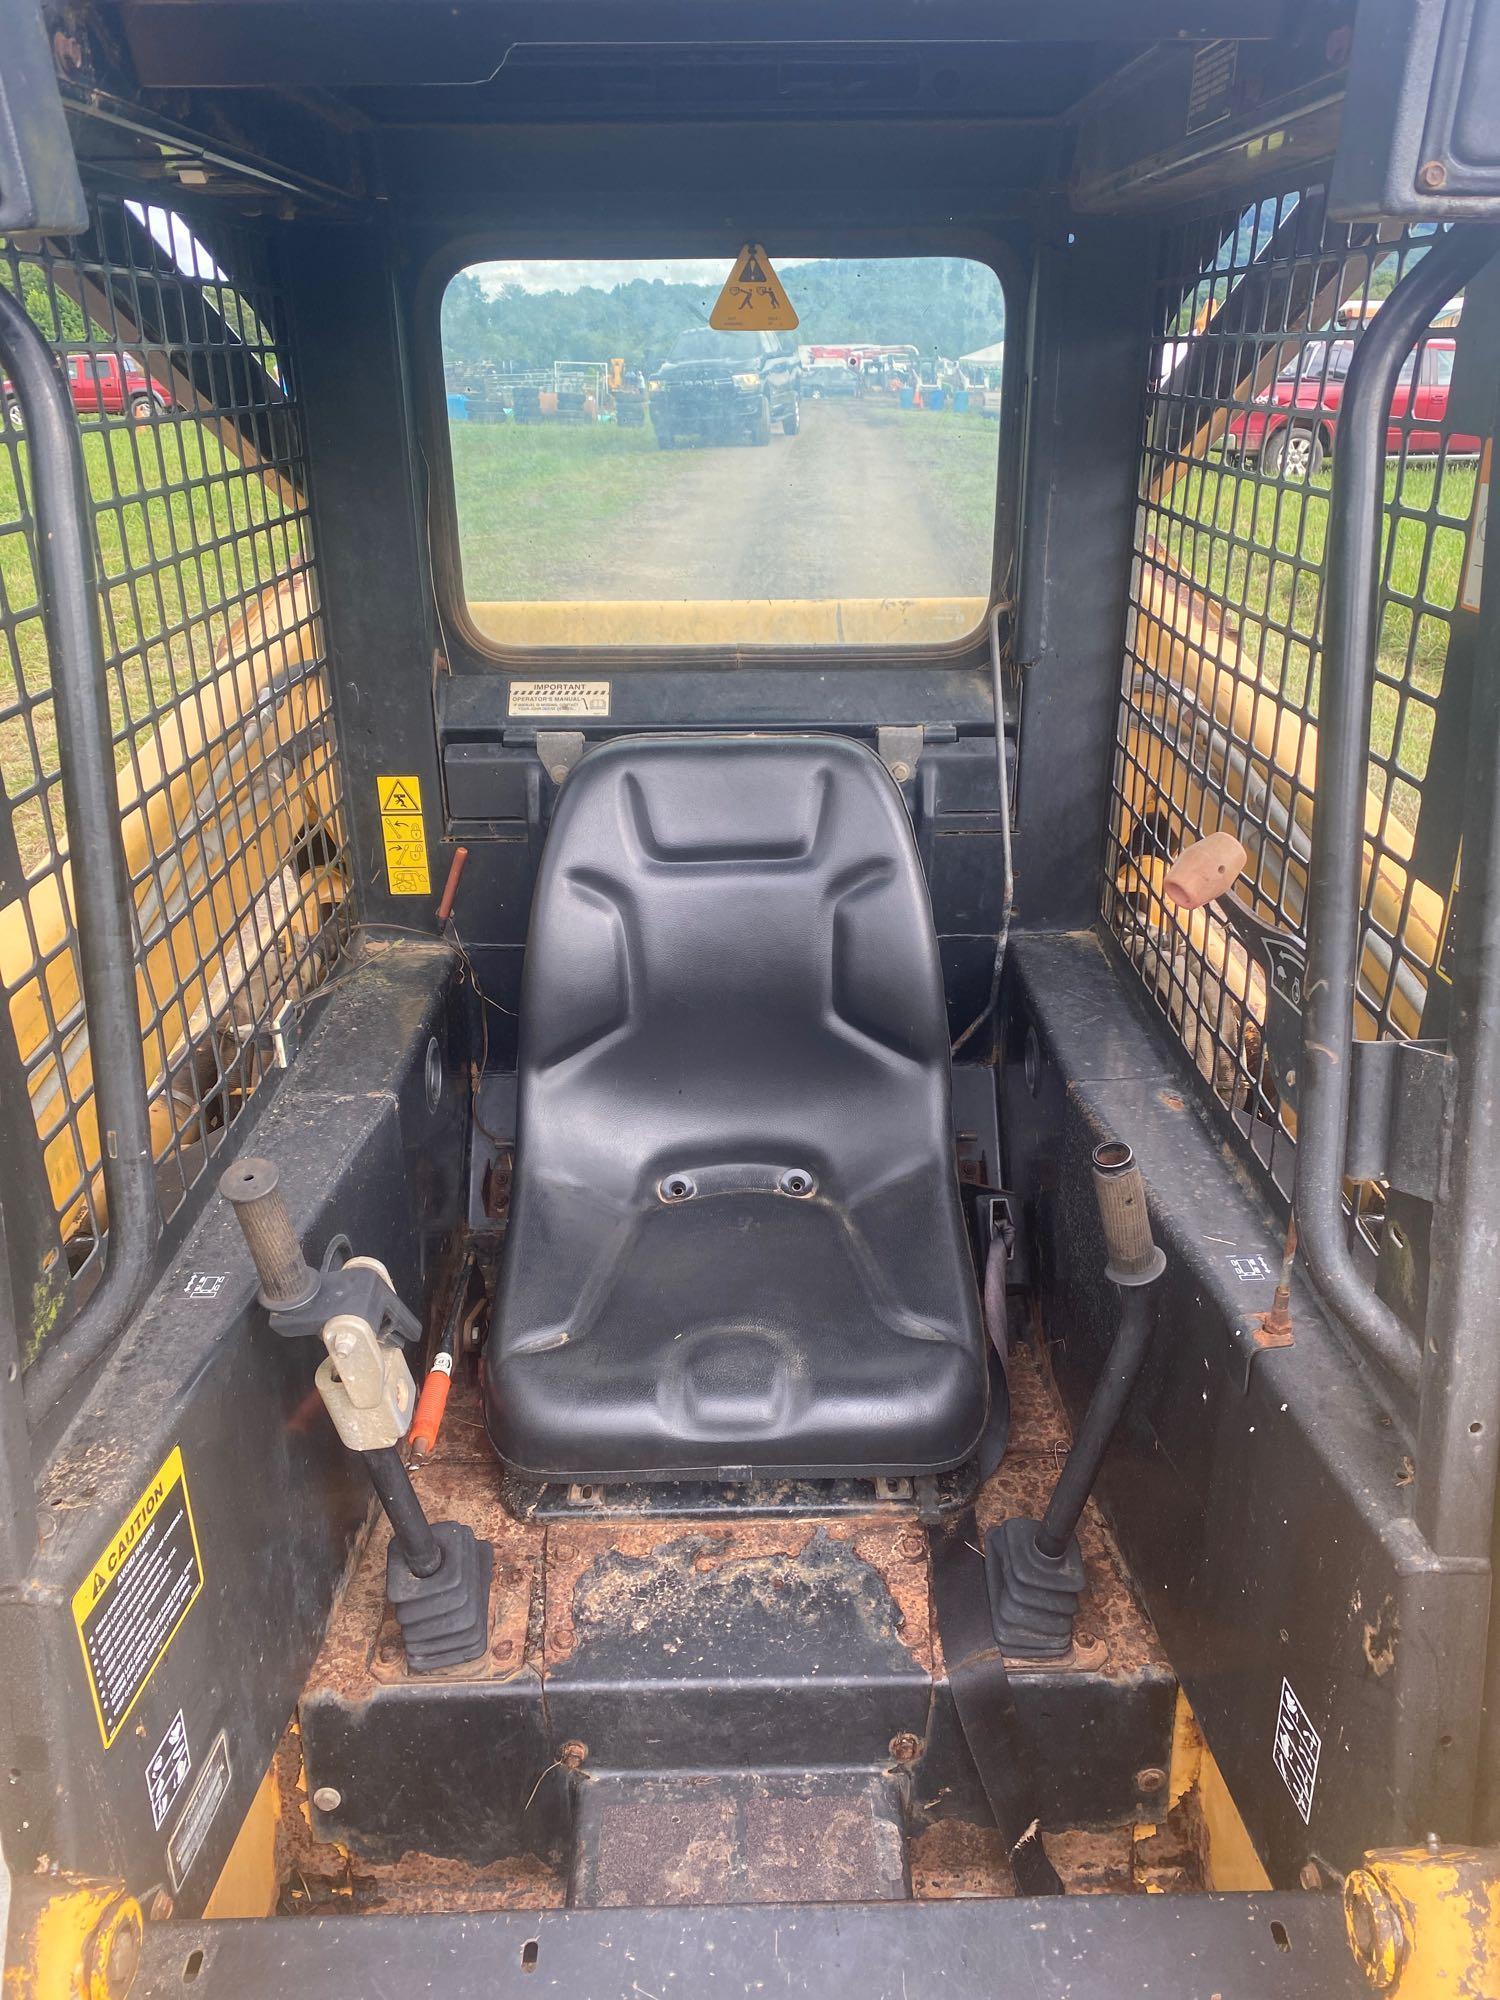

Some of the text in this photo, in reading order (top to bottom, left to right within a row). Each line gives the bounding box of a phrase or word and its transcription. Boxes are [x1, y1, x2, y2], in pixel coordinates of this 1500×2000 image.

[107, 1482, 164, 1571] CAUTION
[118, 1523, 155, 1587] AVOID INJURY
